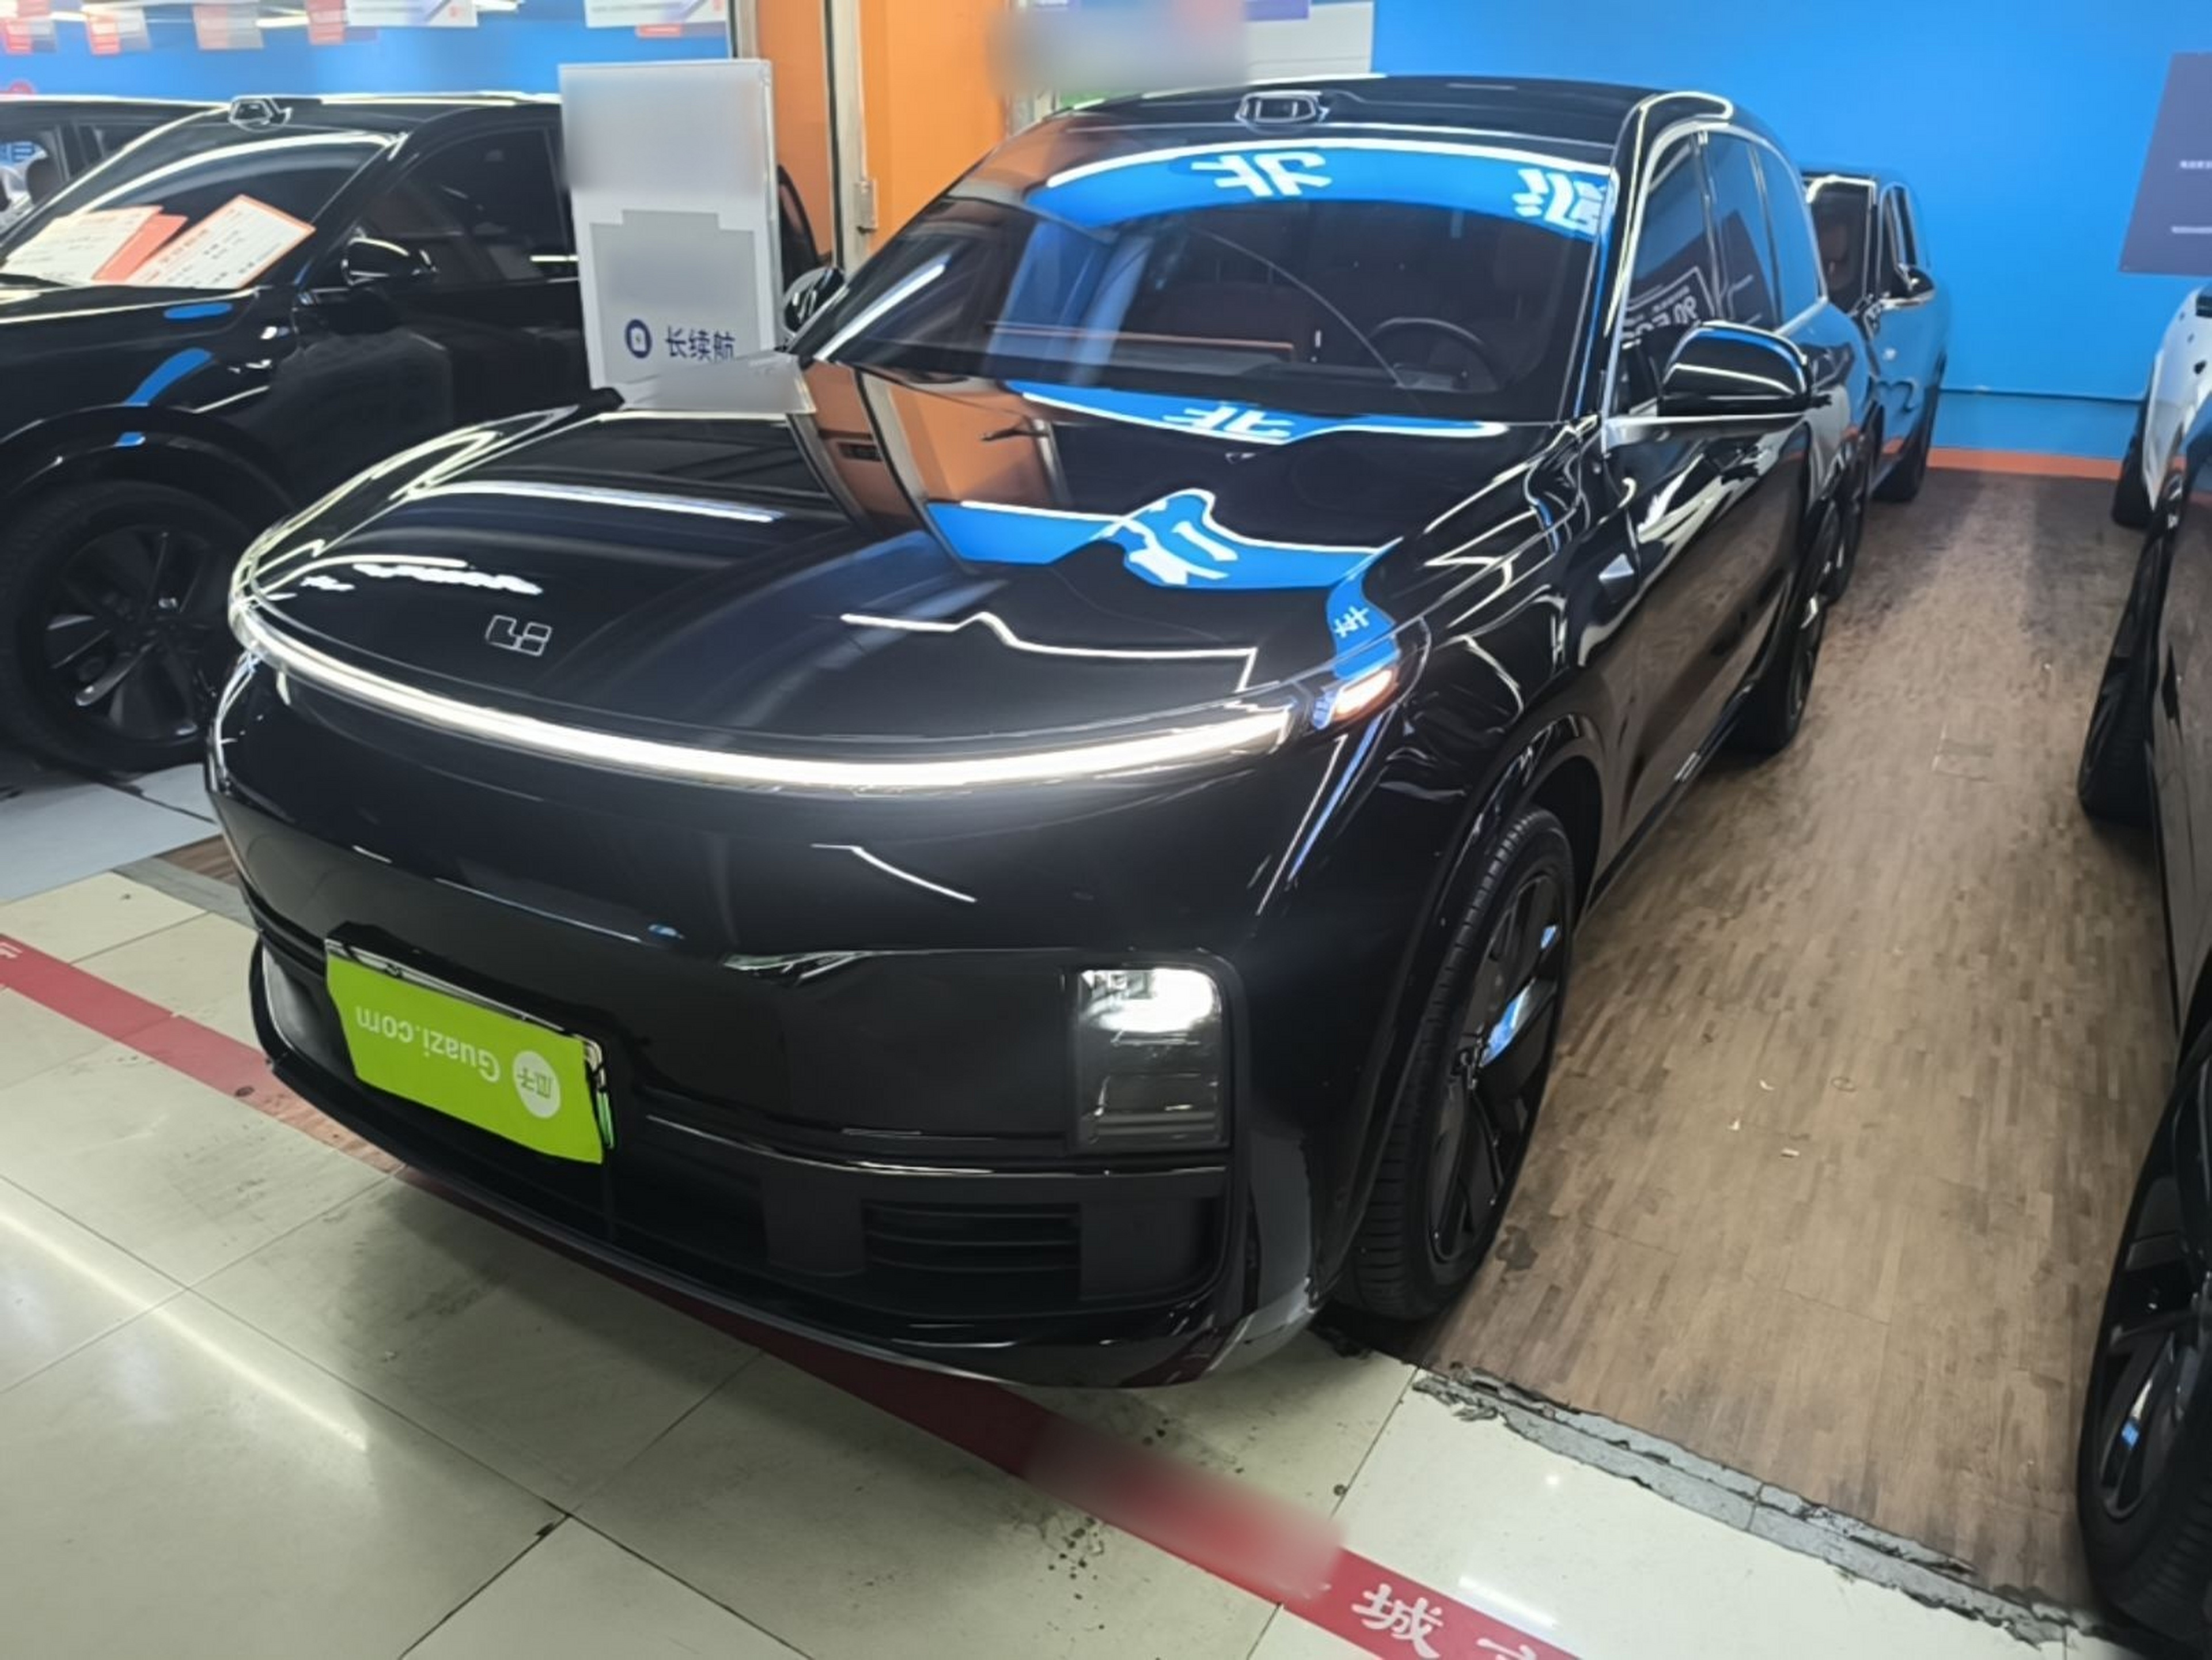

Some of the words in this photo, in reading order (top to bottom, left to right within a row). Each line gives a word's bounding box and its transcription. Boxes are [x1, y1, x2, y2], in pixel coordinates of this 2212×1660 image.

[665, 325, 736, 362] 长续航
[355, 1005, 500, 1082] Guazi.com
[516, 1067, 553, 1098] 瓜子
